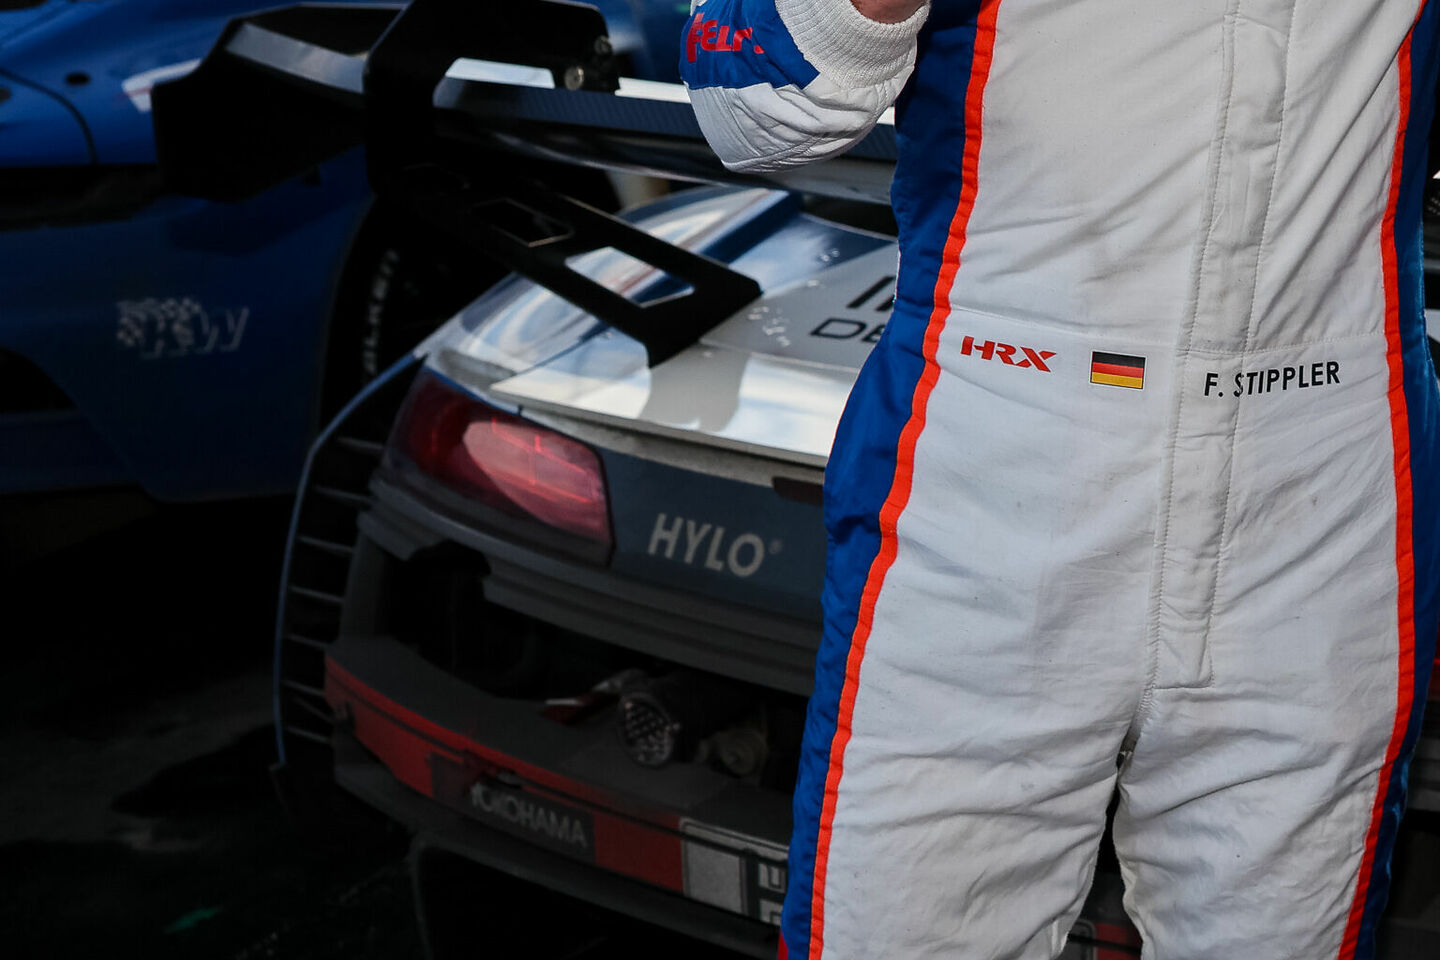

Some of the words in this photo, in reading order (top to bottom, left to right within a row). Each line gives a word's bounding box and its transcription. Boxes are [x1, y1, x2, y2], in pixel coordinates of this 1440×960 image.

[960, 335, 1057, 373] HRX
[1204, 372, 1224, 397] F.
[1233, 361, 1341, 398] STIPPLER
[648, 512, 765, 578] HYLO
